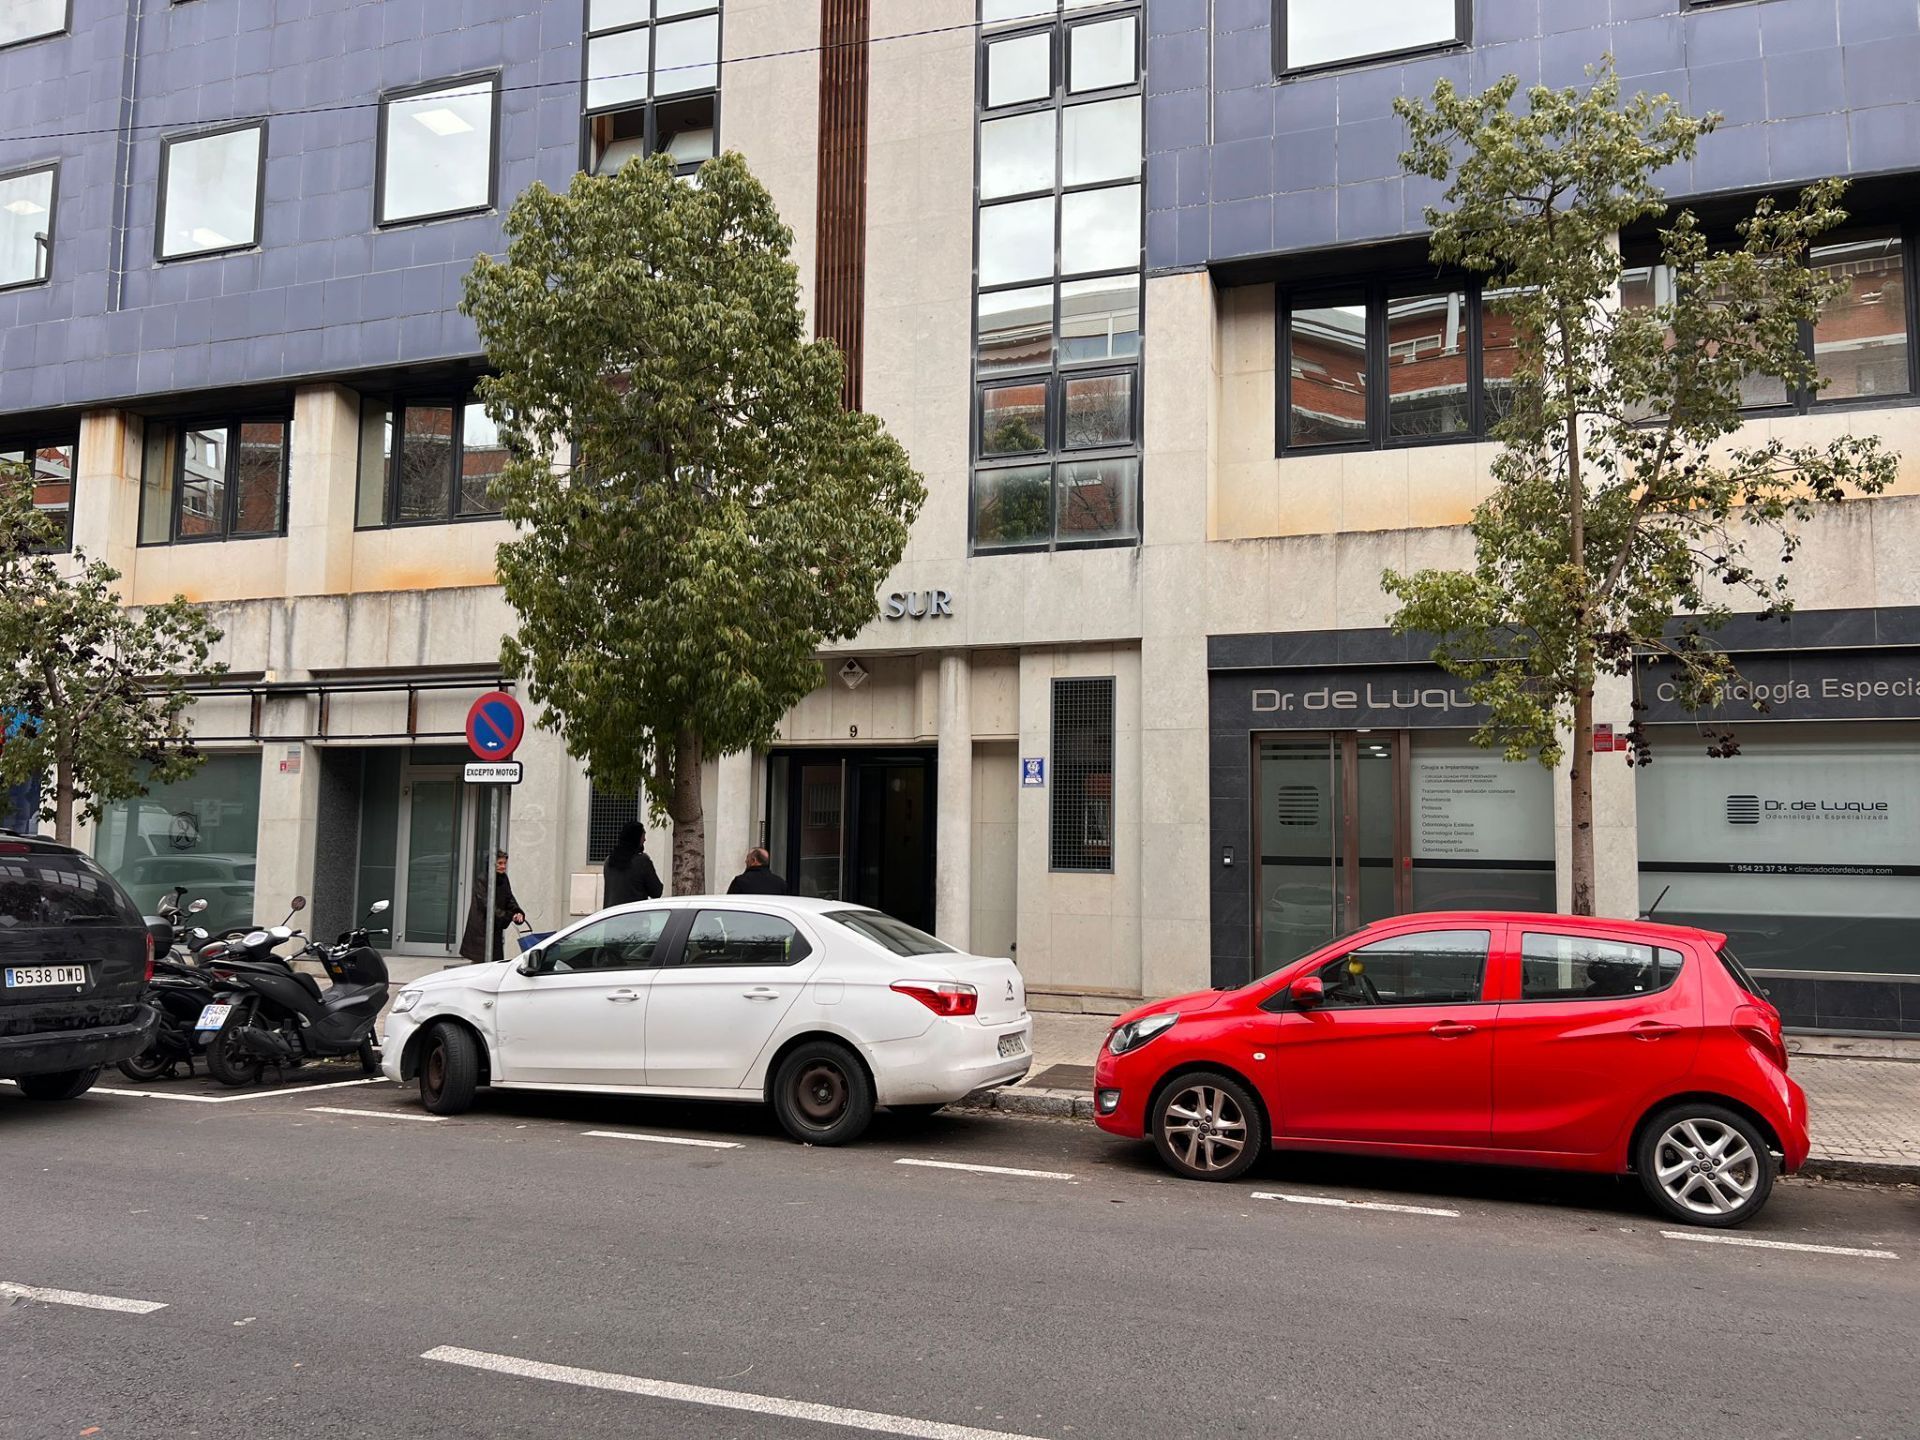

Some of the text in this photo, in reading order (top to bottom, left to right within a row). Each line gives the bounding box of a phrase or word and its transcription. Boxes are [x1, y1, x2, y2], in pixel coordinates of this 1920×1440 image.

[885, 590, 953, 618] SUR
[1252, 682, 1492, 712] Dr. de Luqu
[850, 725, 858, 738] 9
[466, 768, 518, 776] EXCEPTO MOTOS
[1765, 800, 1888, 813] Dr. de Luque
[1825, 813, 1889, 821] Especializada
[1794, 866, 1893, 875] clinicadoctordeluque.com
[15, 967, 83, 985] 6538 DWD
